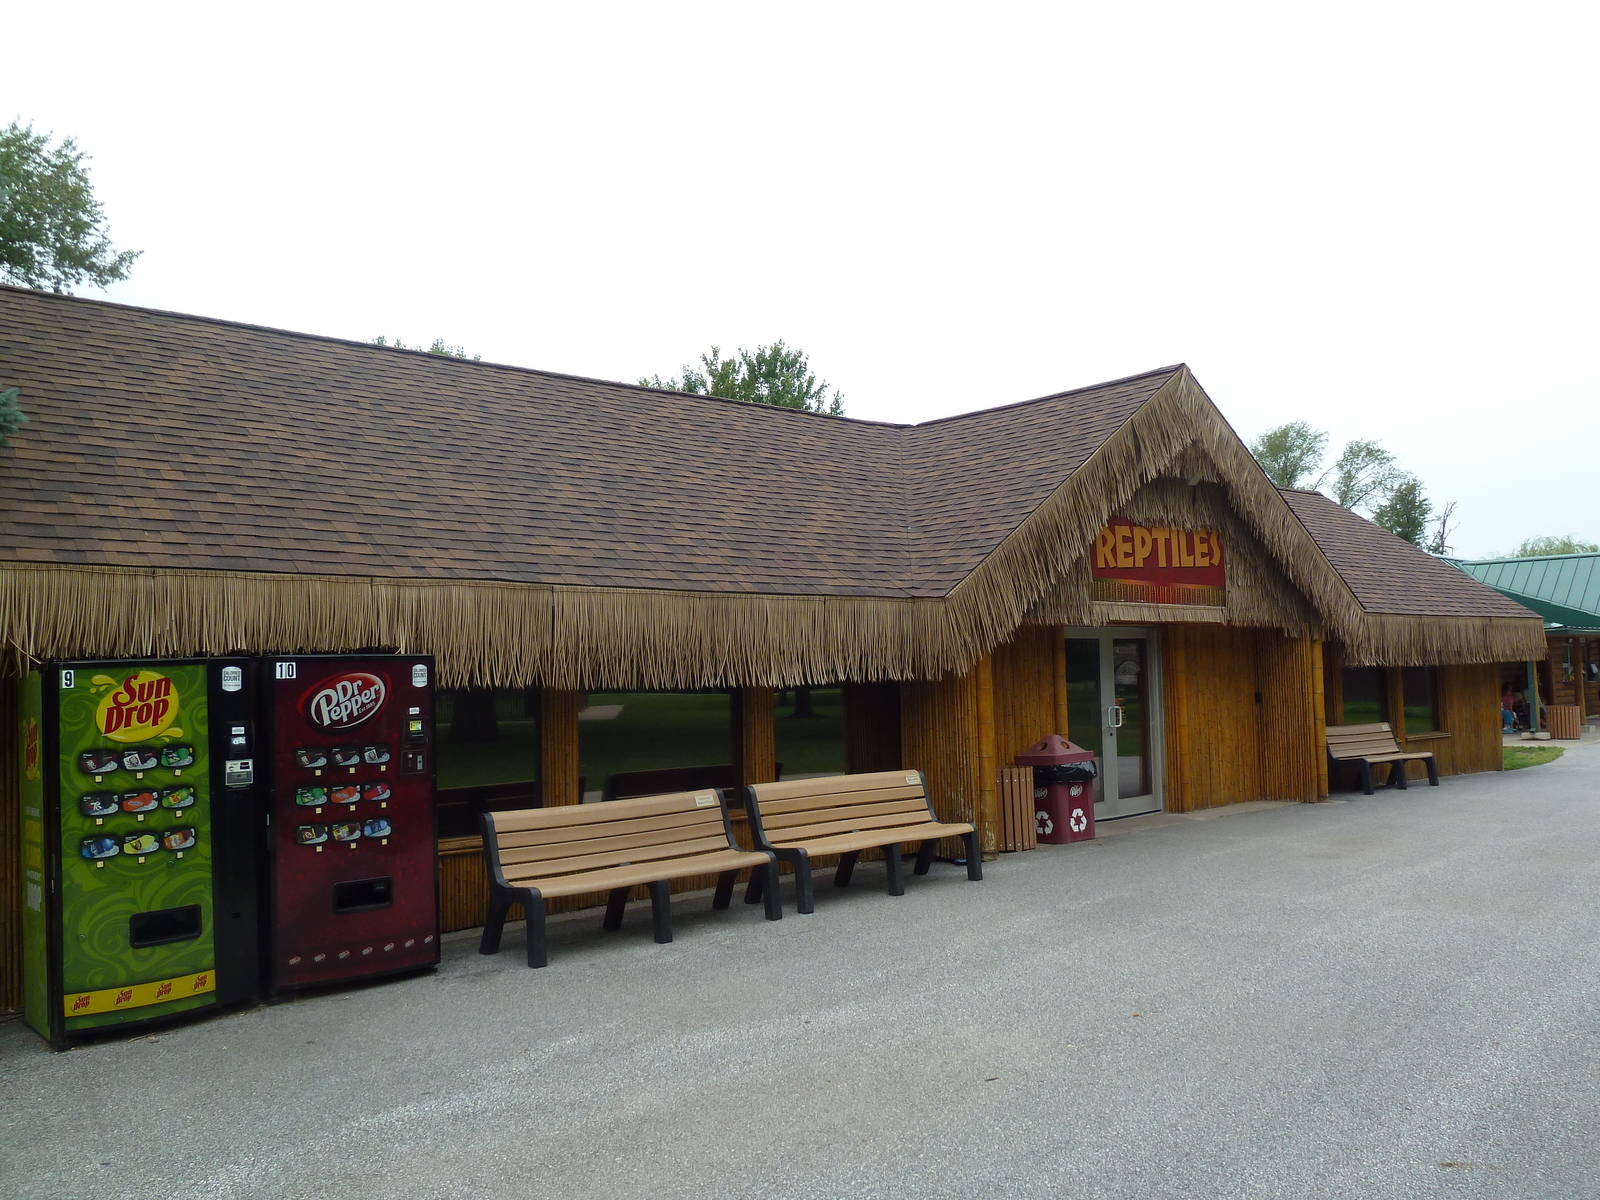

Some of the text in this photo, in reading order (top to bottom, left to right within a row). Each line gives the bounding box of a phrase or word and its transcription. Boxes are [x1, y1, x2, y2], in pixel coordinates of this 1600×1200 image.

[1095, 525, 1221, 569] REPTILES
[64, 671, 73, 688] 9
[278, 663, 295, 678] 10
[112, 674, 171, 707] Sun
[315, 683, 381, 727] Pepper
[336, 679, 363, 701] Dr
[103, 698, 170, 735] Drop
